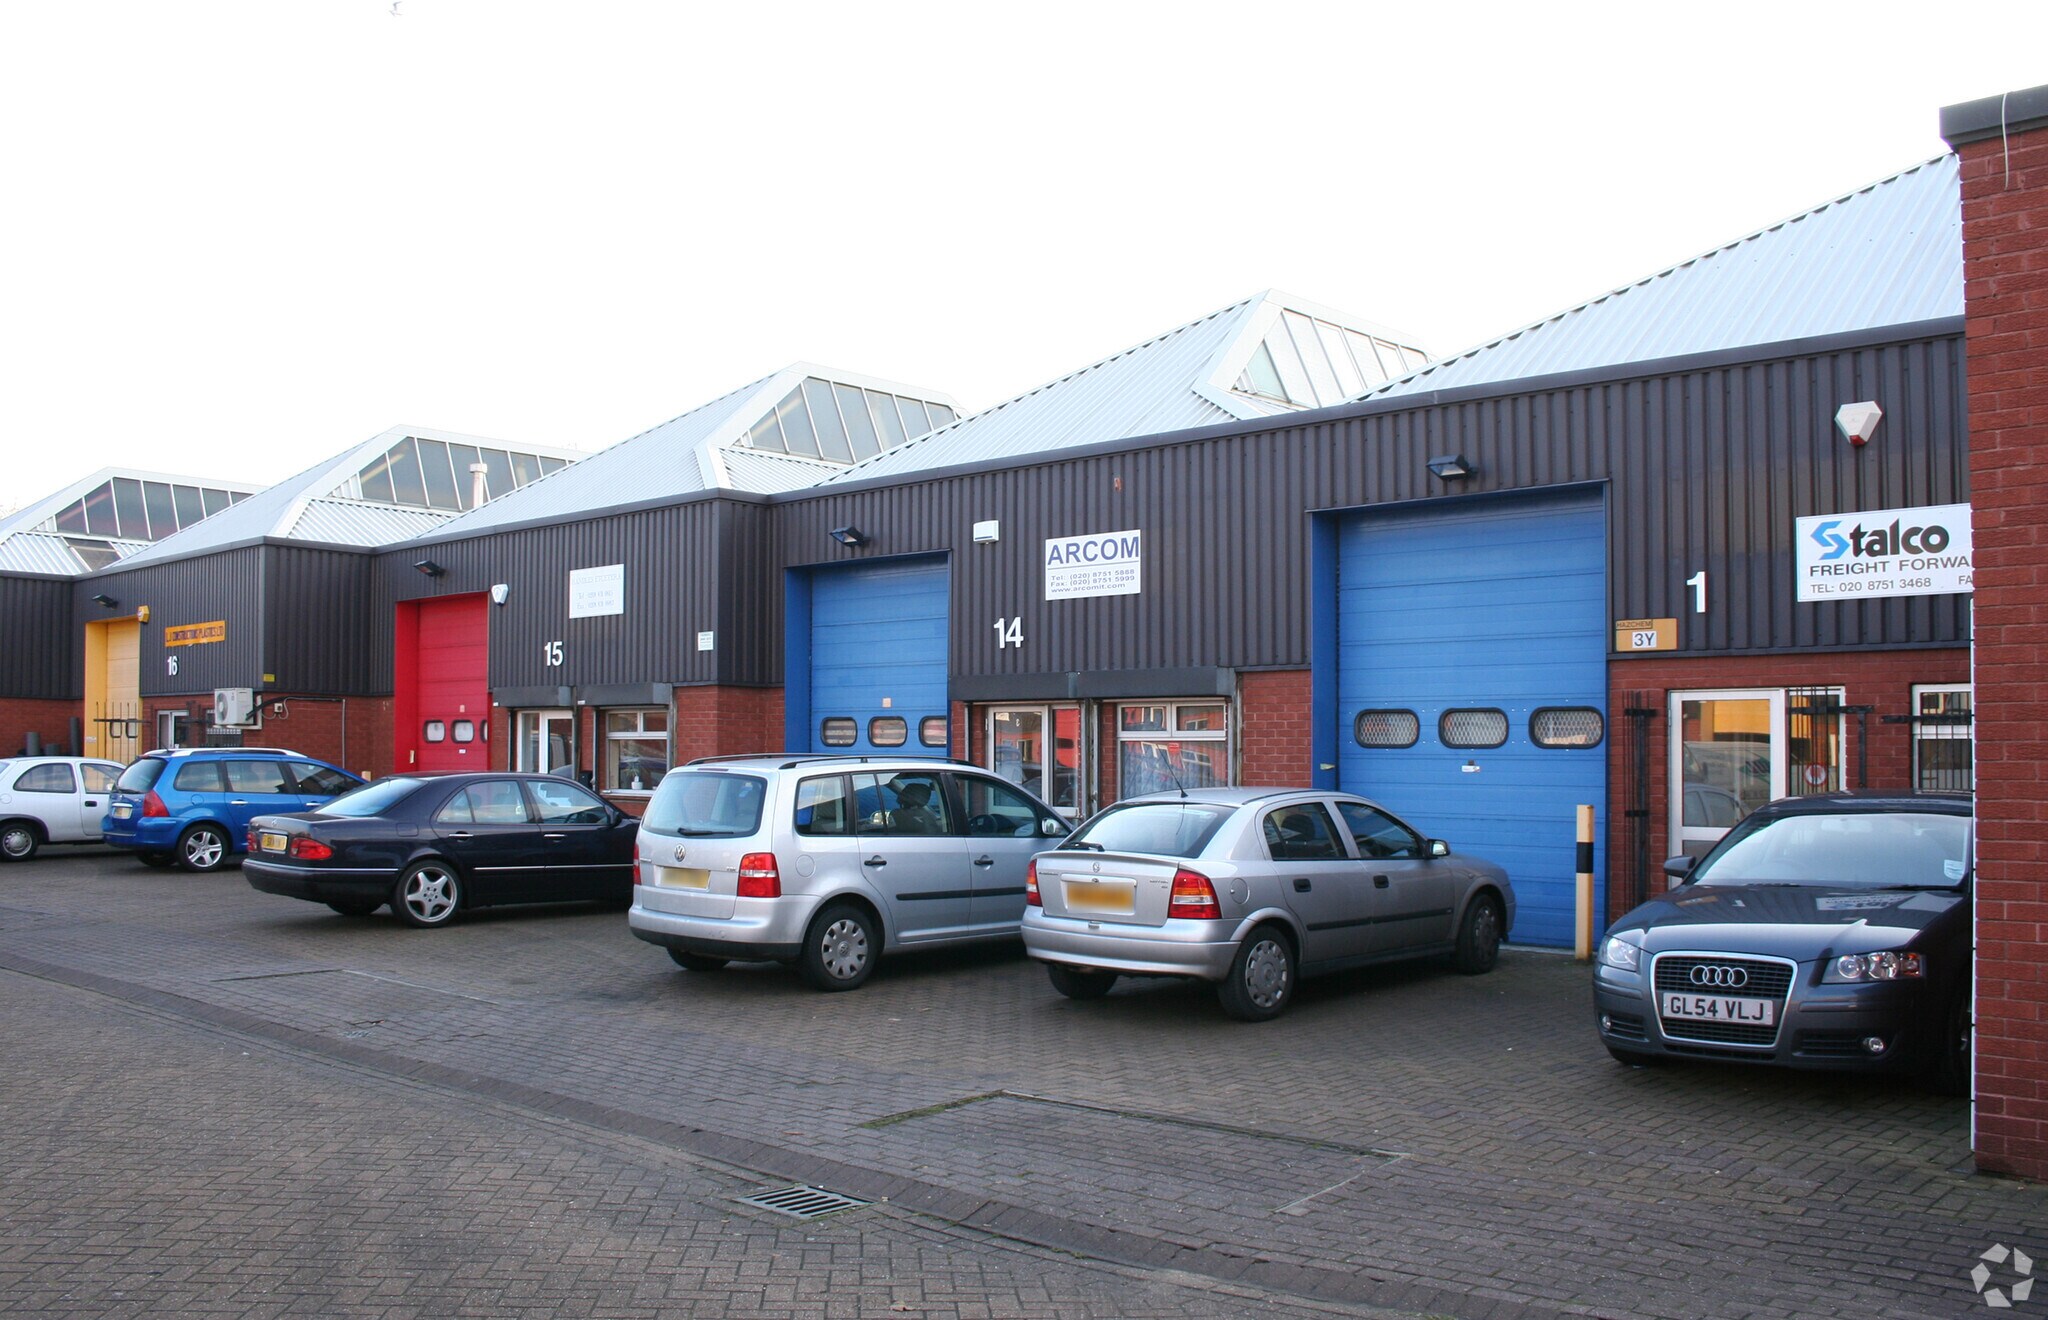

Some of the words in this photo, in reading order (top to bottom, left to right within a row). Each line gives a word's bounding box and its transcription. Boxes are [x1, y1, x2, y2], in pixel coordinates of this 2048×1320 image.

[1047, 536, 1139, 565] ARCOM
[1069, 572, 1090, 580] (020)
[1810, 561, 1890, 577] FREIGHT
[1051, 583, 1126, 593] www.arcomit.com
[1686, 571, 1705, 613] 1
[1810, 584, 1835, 594] TEL:
[1839, 582, 1863, 592] 020
[1867, 580, 1894, 590] 8751
[1899, 577, 1932, 588] 3468
[993, 616, 1024, 648] 14
[1616, 620, 1652, 628] HAZCHEM
[1634, 632, 1655, 647] 3Y
[544, 641, 563, 666] 15
[167, 655, 178, 675] 16
[1670, 997, 1718, 1017] GL54
[1725, 1000, 1764, 1020] VLJ
